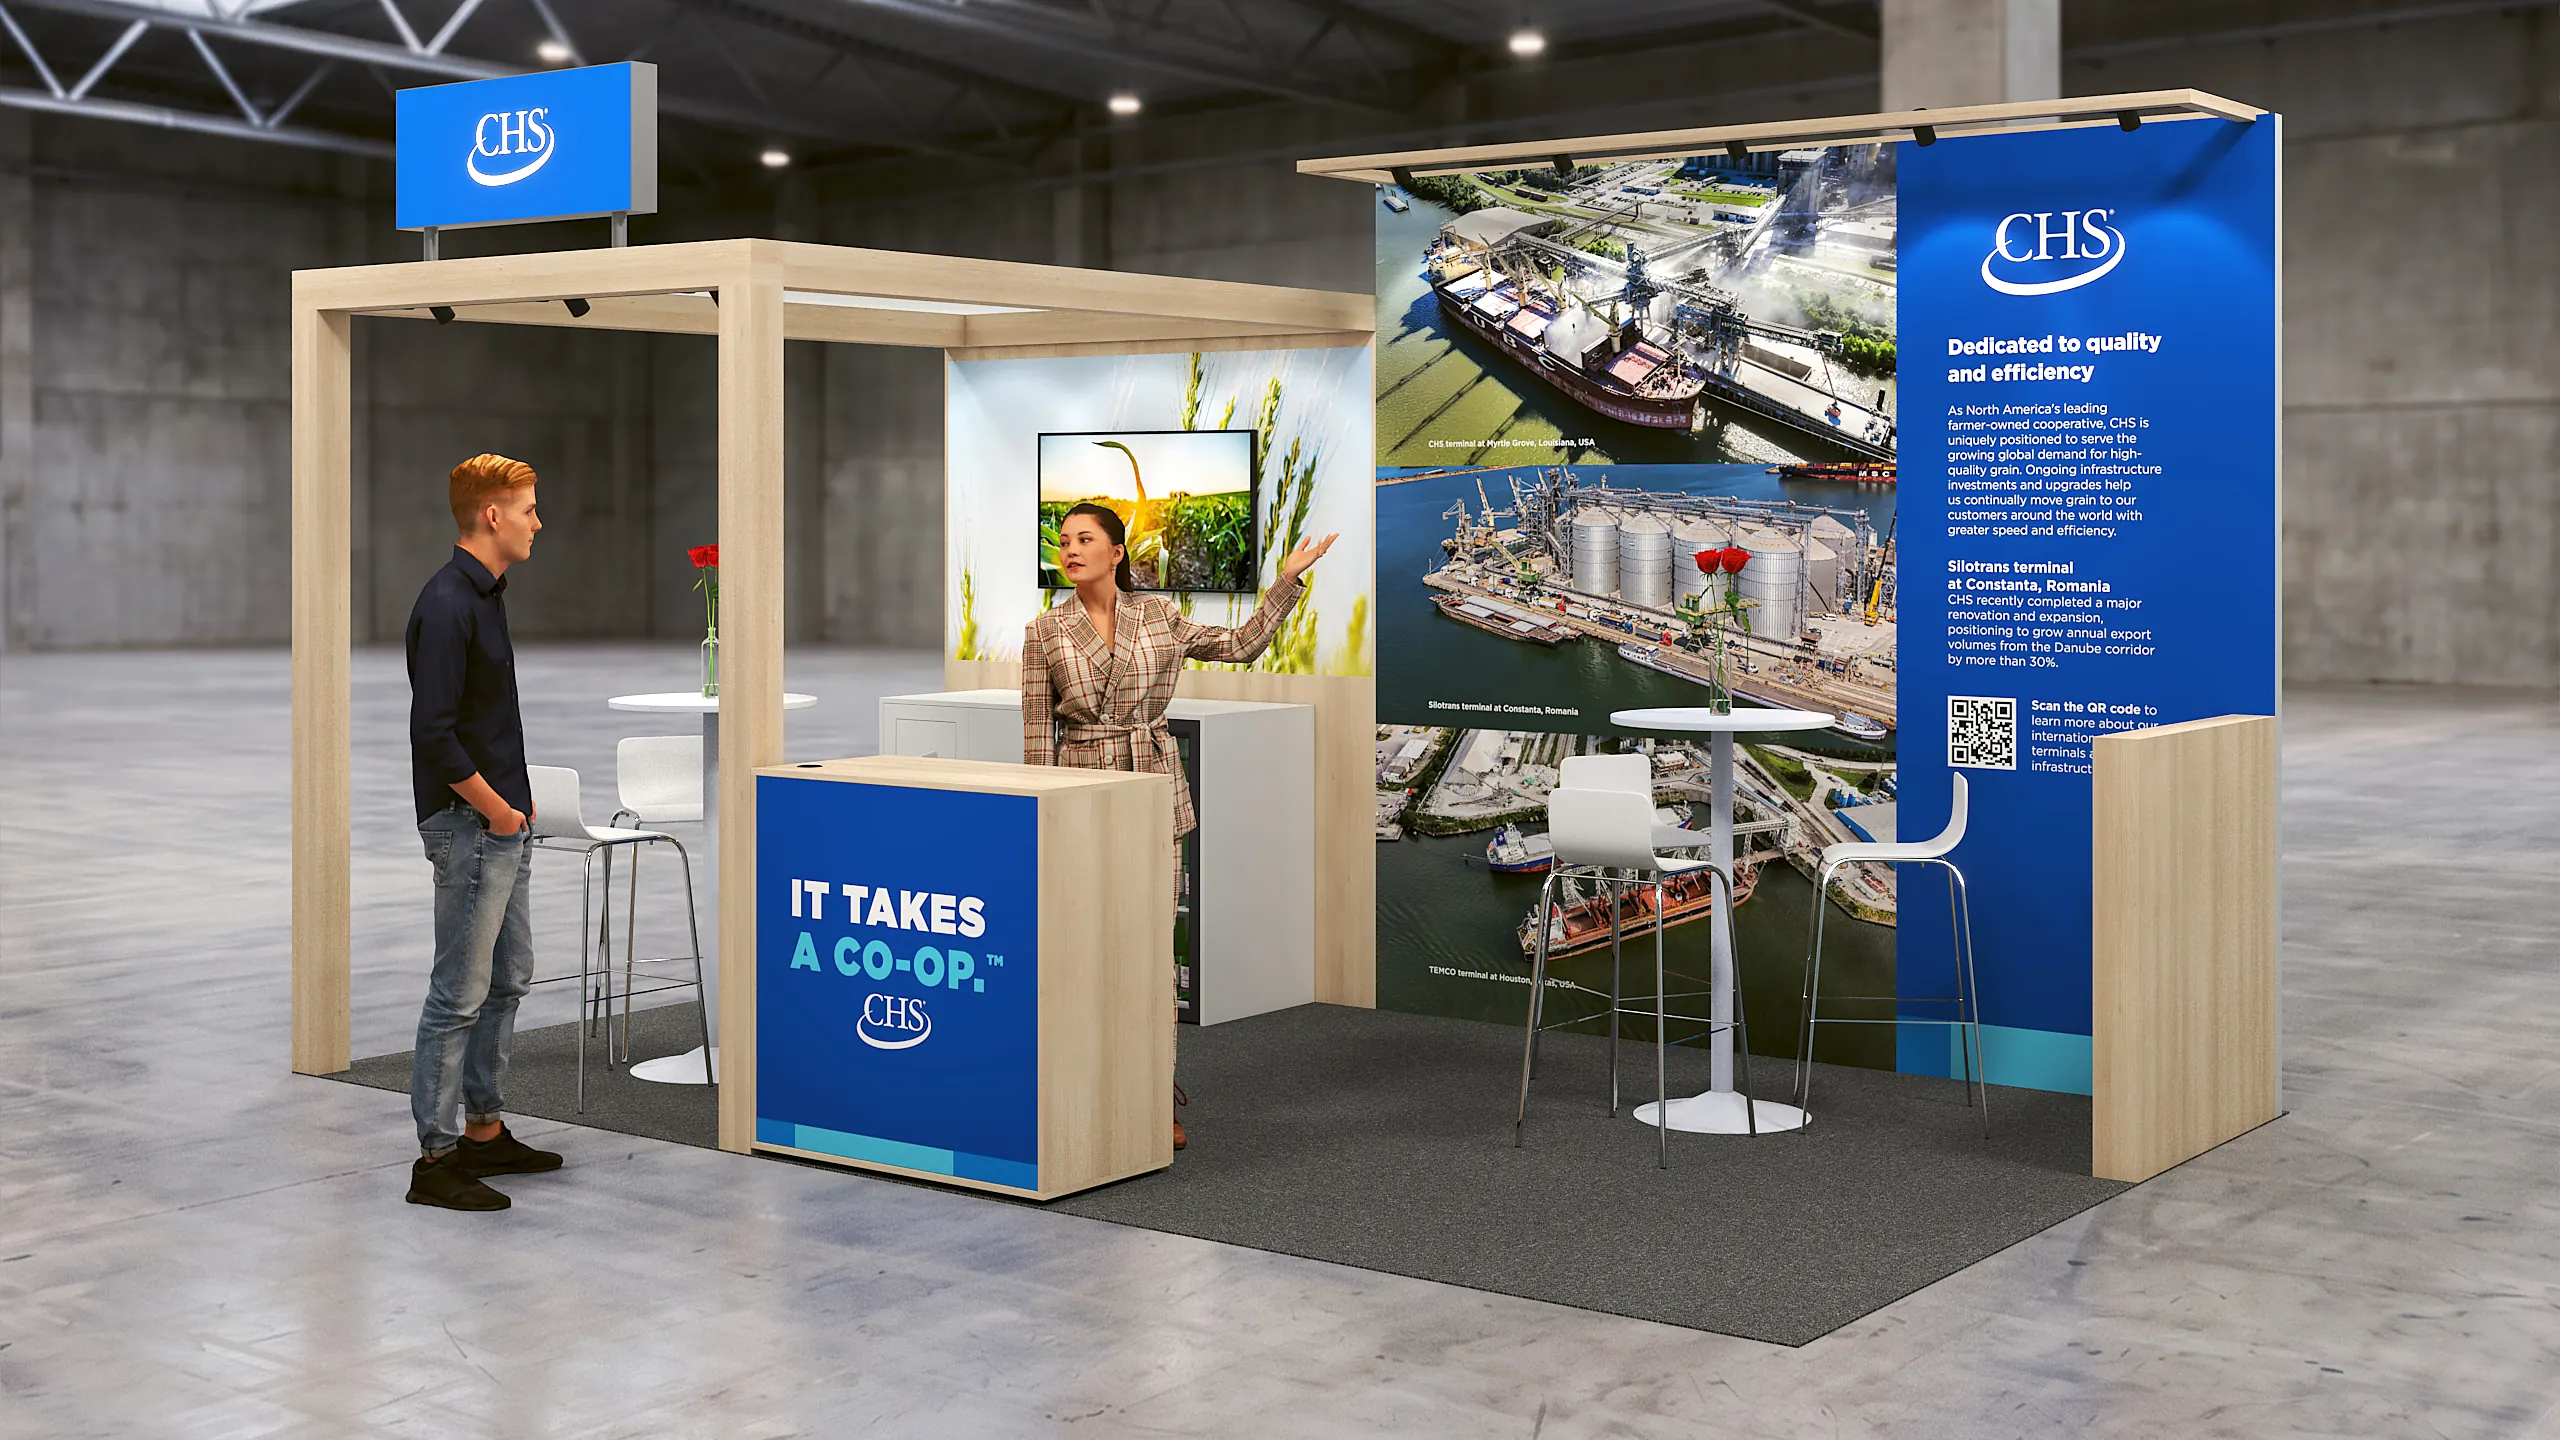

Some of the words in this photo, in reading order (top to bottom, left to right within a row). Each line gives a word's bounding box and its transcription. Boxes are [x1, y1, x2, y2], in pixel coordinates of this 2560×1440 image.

[475, 107, 546, 157] CHS
[1949, 335, 2052, 355] Dedicated
[2058, 336, 2080, 352] to
[2086, 333, 2162, 356] quality
[1948, 364, 1985, 382] and
[1992, 363, 2094, 384] efficiency
[1948, 405, 1962, 416] As
[1966, 404, 1999, 415] North
[2003, 403, 2060, 415] America's
[2064, 403, 2107, 416] leading
[1948, 418, 2029, 430] farmer-owned
[2033, 418, 2106, 432] cooperative,
[2110, 417, 2136, 428] CHS
[2140, 417, 2149, 428] is
[1428, 440, 1444, 448] CHS
[1445, 439, 1475, 447] terminal
[1487, 439, 1510, 449] Myrtle
[1512, 439, 1537, 448] Grove,
[1539, 438, 1577, 447] Louisiana,
[1578, 438, 1595, 446] USA
[1948, 434, 1996, 448] uniquely
[2000, 433, 2061, 447] positioned
[2065, 434, 2078, 444] to
[2081, 435, 2113, 444] serve
[2117, 432, 2136, 444] the
[1948, 449, 1994, 463] growing
[1998, 448, 2034, 462] global
[2038, 448, 2086, 459] demand
[2090, 448, 2107, 459] for
[2111, 448, 2142, 462] high-
[1948, 464, 1986, 478] quality
[1990, 464, 2022, 478] grain.
[2026, 464, 2076, 477] Ongoing
[2081, 463, 2162, 474] infrastructure
[1948, 479, 2016, 490] investments
[2020, 479, 2042, 490] and
[2046, 478, 2101, 492] upgrades
[2106, 478, 2131, 492] help
[1948, 497, 1960, 505] us
[1964, 494, 2027, 508] continually
[2031, 496, 2062, 505] move
[2066, 494, 2096, 508] grain
[2100, 495, 2112, 505] to
[2116, 496, 2136, 505] our
[1948, 510, 2007, 520] customers
[2011, 509, 2052, 520] around
[2056, 509, 2075, 520] the
[2079, 509, 2112, 520] world
[2116, 509, 2142, 520] with
[1948, 525, 1989, 538] greater
[1993, 524, 2028, 538] speed
[2031, 524, 2053, 535] and
[2057, 525, 2116, 539] efficiency.
[1948, 559, 2009, 573] Silotrans
[2014, 560, 2073, 574] terminal
[1948, 578, 1962, 590] at
[1966, 577, 2042, 594] Constanta,
[2047, 578, 2110, 592] Romania
[1948, 594, 1973, 605] CHS
[1977, 595, 2024, 609] recently
[2028, 596, 2091, 610] completed
[2095, 599, 2103, 608] a
[2107, 597, 2142, 611] major
[1948, 610, 2010, 621] renovation
[2014, 611, 2035, 622] and
[2040, 612, 2103, 625] expansion,
[1948, 624, 2013, 639] positioning
[2017, 626, 2029, 637] to
[2033, 628, 2063, 640] grow
[2067, 627, 2106, 638] annual
[2111, 629, 2151, 642] export
[1948, 639, 1996, 651] volumes
[2000, 640, 2027, 652] from
[2031, 641, 2050, 652] the
[2054, 642, 2101, 654] Danube
[2105, 643, 2155, 655] corridor
[1948, 654, 1962, 668] by
[1966, 657, 1996, 666] more
[2000, 655, 2025, 667] than
[2030, 656, 2058, 667] 30%.
[1428, 701, 1460, 710] Silotrans
[1462, 703, 1492, 711] terminal
[1503, 704, 1543, 715] Constanta,
[1545, 706, 1579, 715] Romania
[2032, 699, 2060, 711] Scan
[2064, 701, 2083, 712] the
[2087, 702, 2106, 713] QR
[2110, 703, 2141, 715] code
[2145, 705, 2157, 715] to
[2032, 714, 2060, 726] learn
[2064, 718, 2095, 727] more
[2099, 717, 2134, 729] about
[2032, 730, 2094, 743] internation
[2032, 746, 2086, 758] terminals
[2032, 760, 2093, 774] infrastruct
[791, 878, 830, 919] IT
[842, 883, 986, 938] TAKES
[790, 931, 821, 972] A
[1429, 966, 1456, 976] TEMCO
[1458, 969, 1488, 979] terminal
[1500, 973, 1532, 985] Houston,
[863, 993, 925, 1032] CHS
